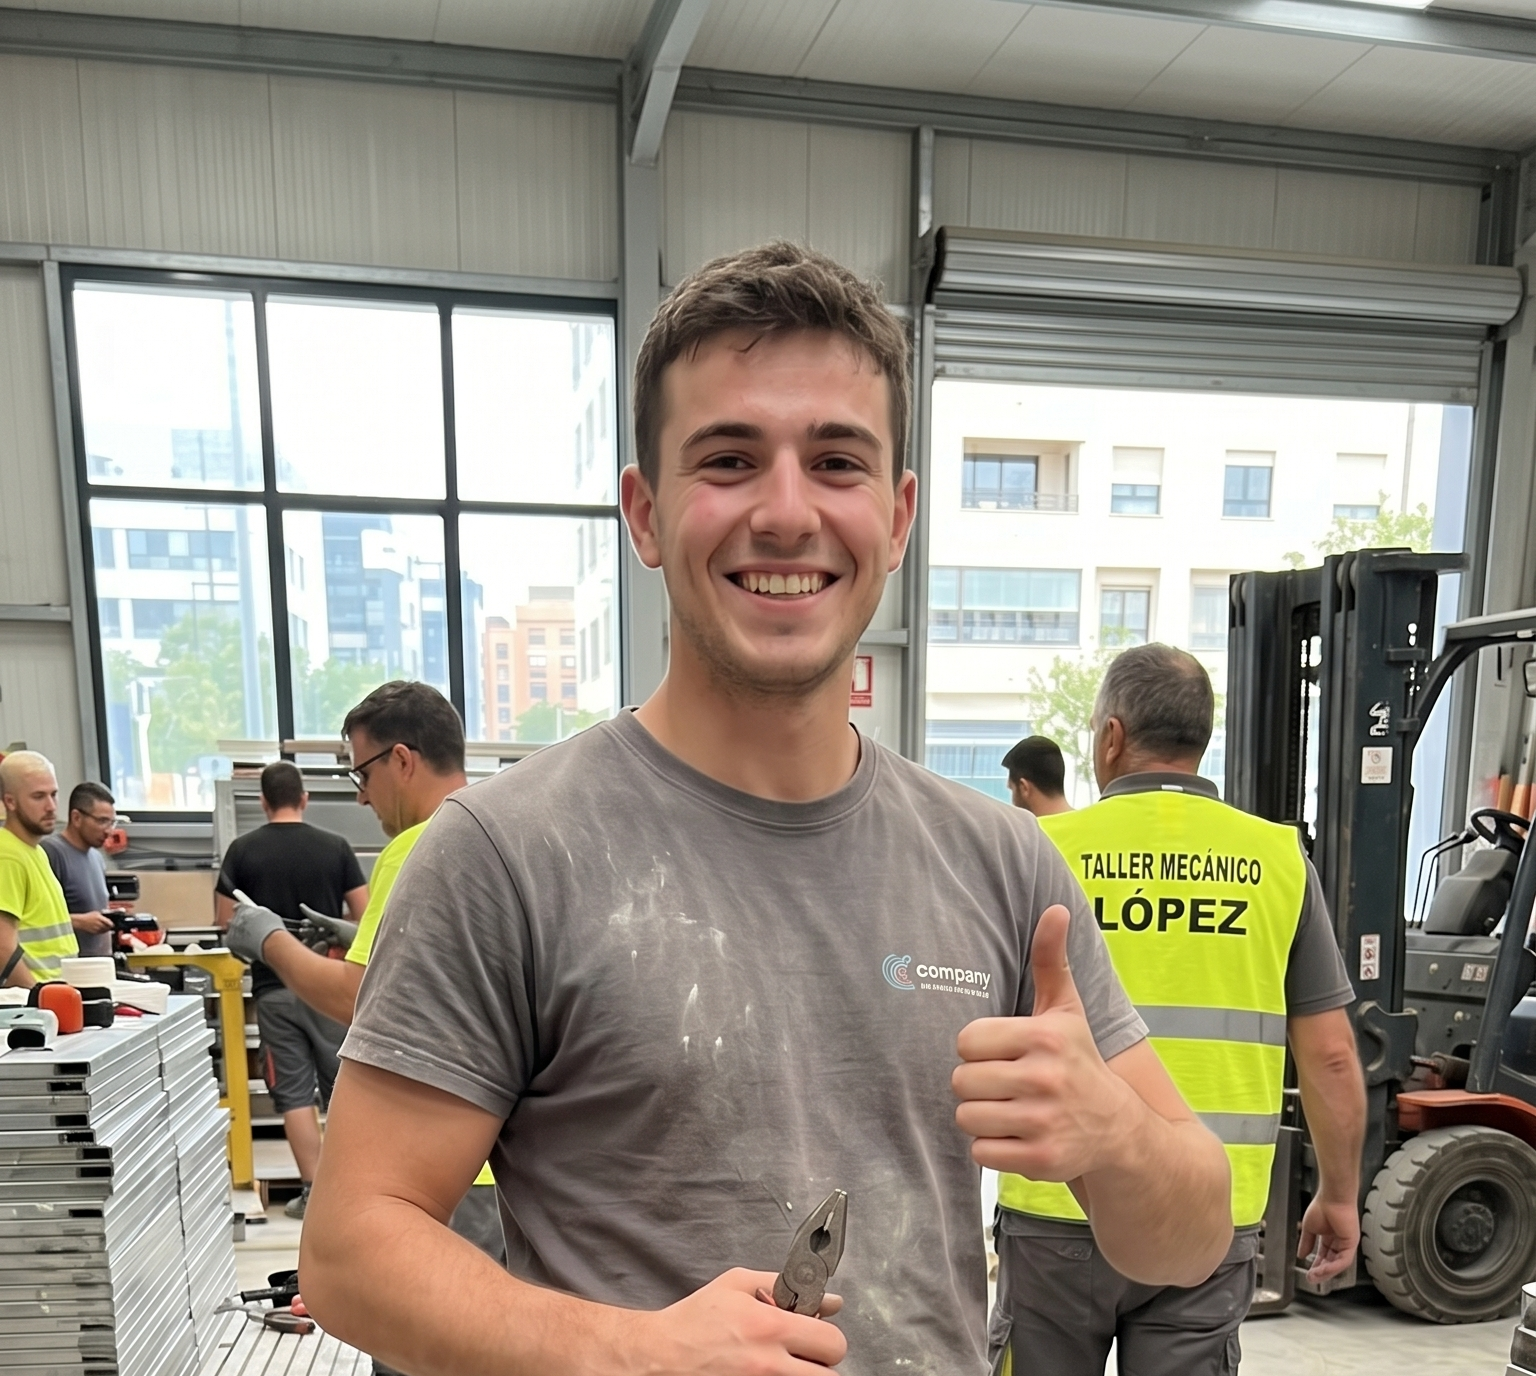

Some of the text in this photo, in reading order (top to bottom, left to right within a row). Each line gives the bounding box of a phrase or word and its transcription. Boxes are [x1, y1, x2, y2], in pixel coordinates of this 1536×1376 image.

[1081, 848, 1261, 885] TALLER MECÁNICO
[1094, 888, 1248, 935] LÓPEZ
[916, 964, 991, 990] company
